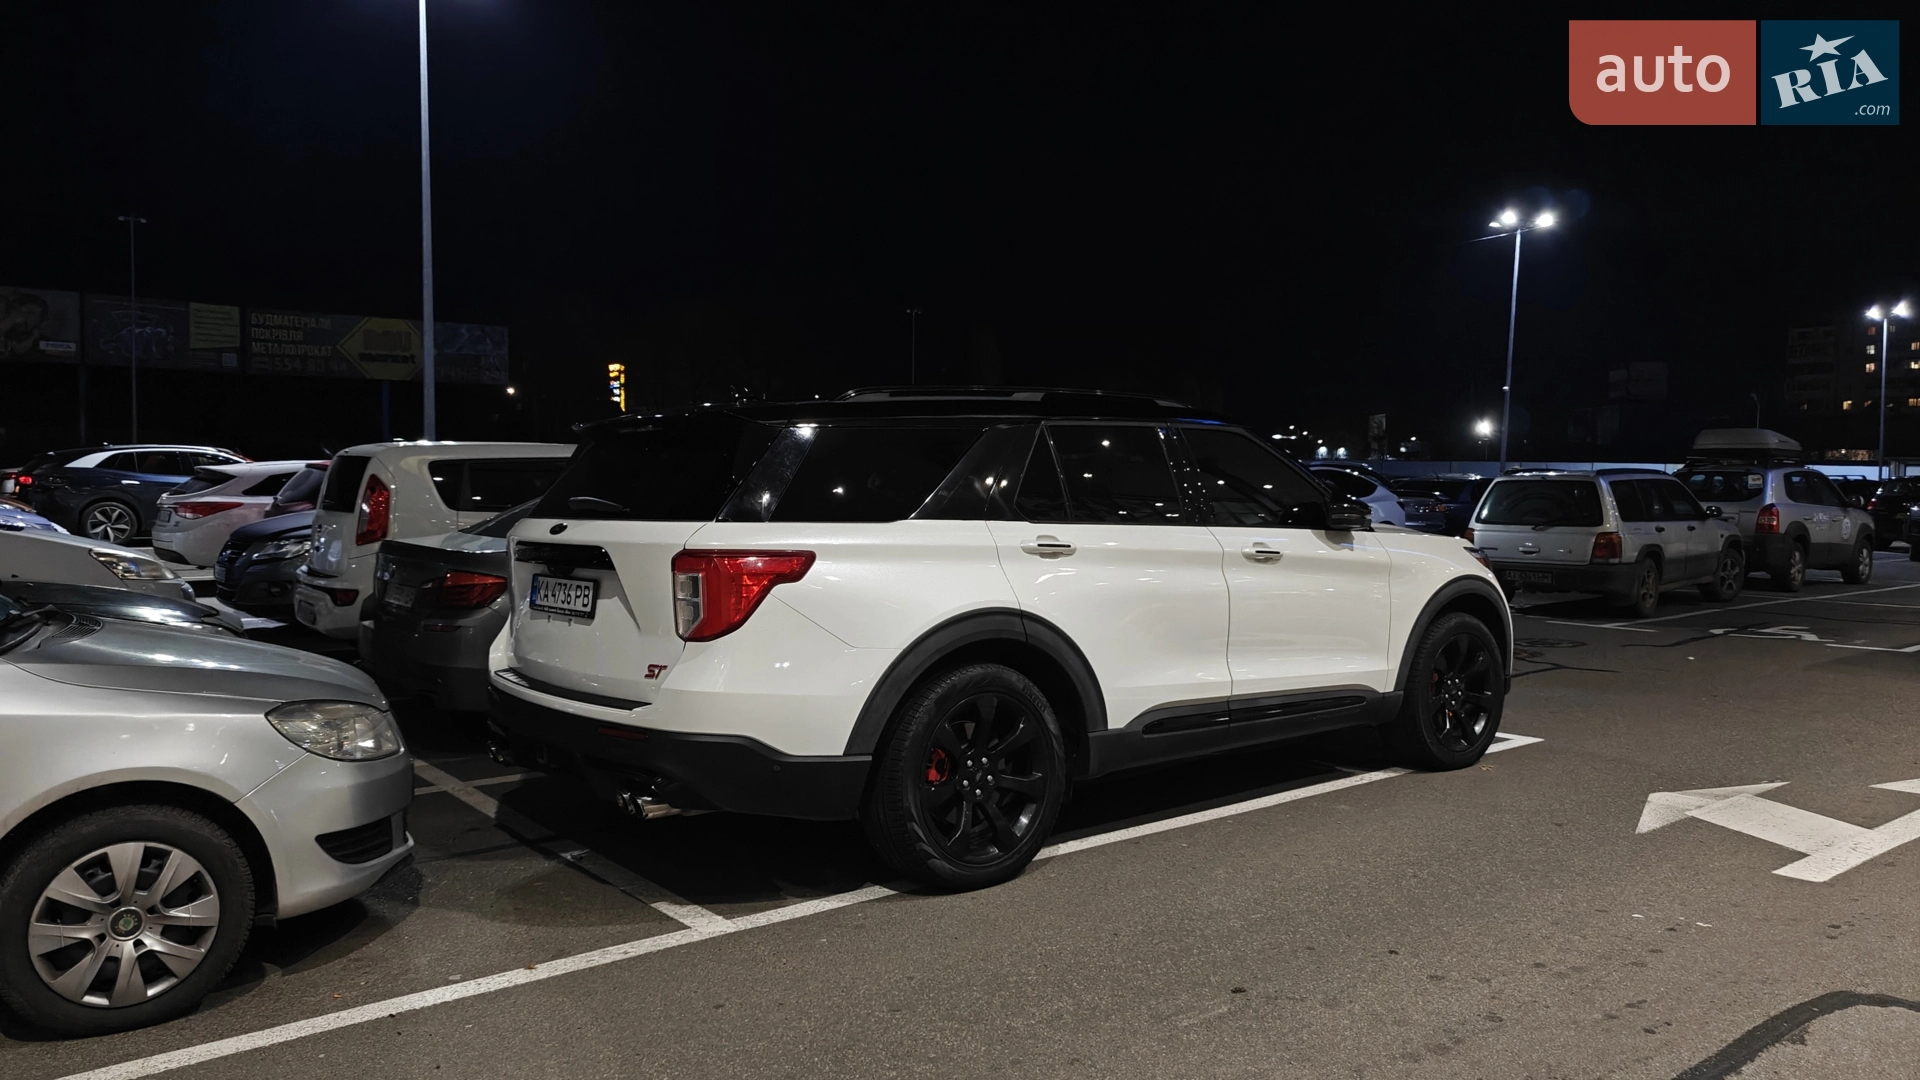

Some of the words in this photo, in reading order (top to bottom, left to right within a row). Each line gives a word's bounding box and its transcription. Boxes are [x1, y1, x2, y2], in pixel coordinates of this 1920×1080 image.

[537, 580, 549, 603] KA
[551, 581, 573, 605] 4736
[574, 584, 591, 607] PB
[644, 664, 668, 680] ST
